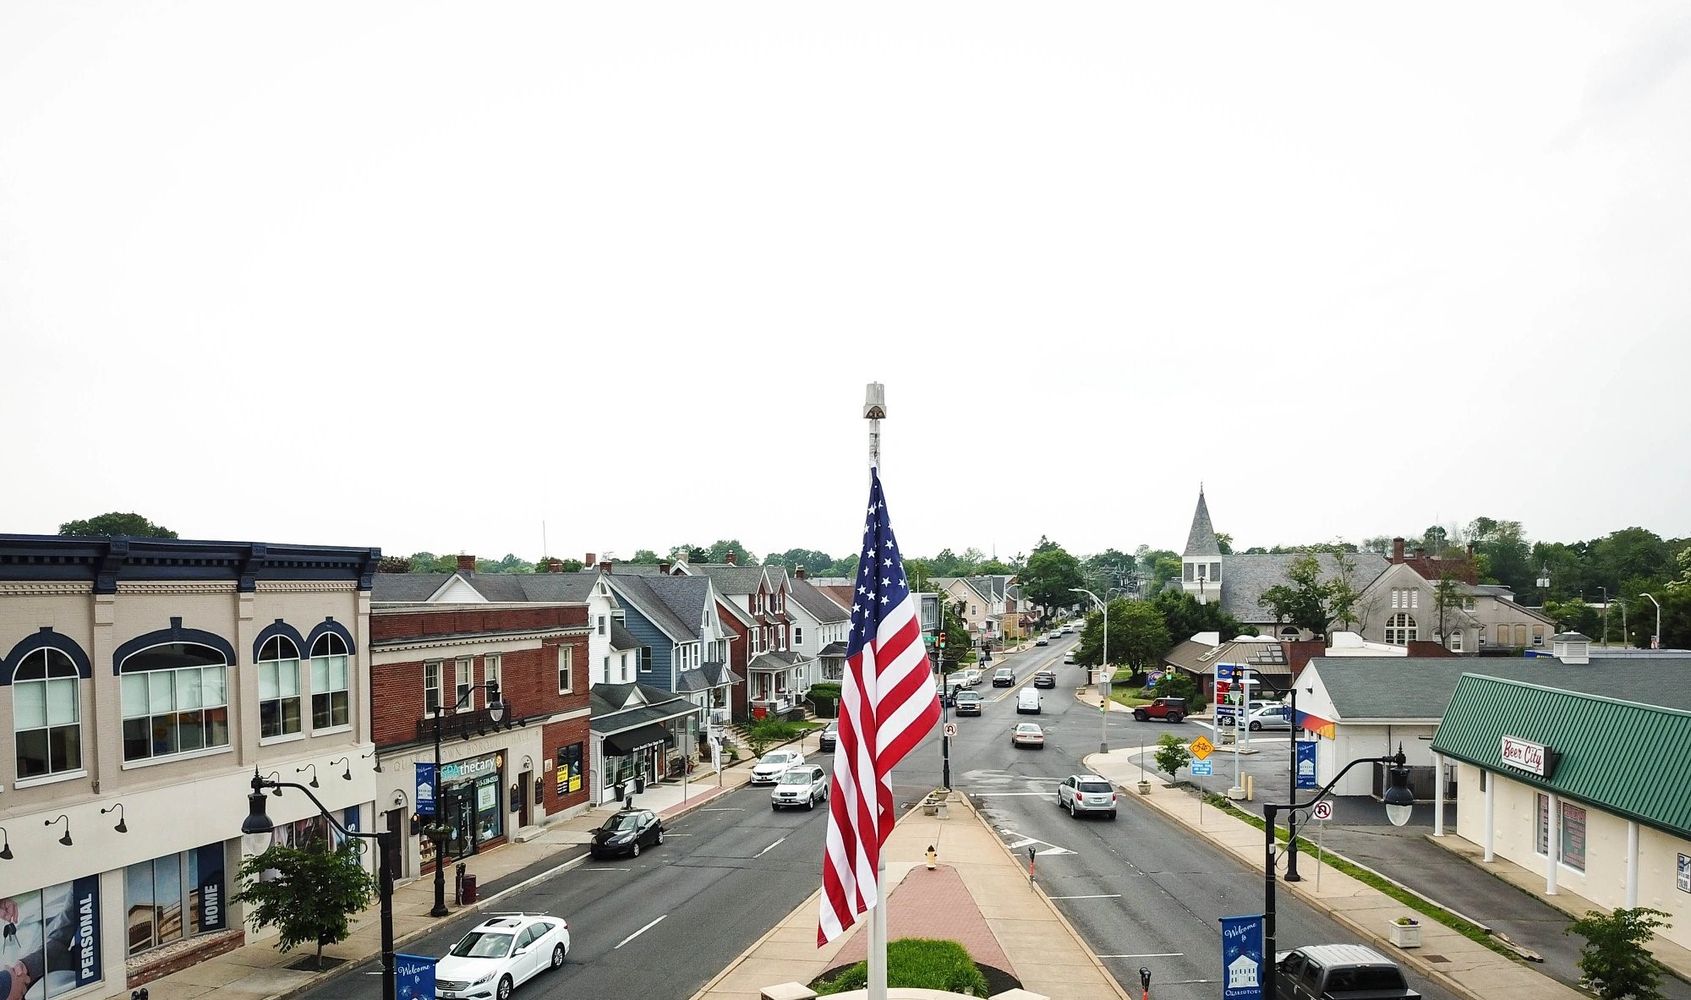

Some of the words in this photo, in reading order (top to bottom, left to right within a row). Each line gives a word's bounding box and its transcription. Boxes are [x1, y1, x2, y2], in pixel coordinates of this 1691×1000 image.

[1504, 740, 1521, 759] Beer
[1524, 746, 1542, 772] City
[204, 884, 219, 926] HOME
[79, 893, 94, 979] PERSONAL
[1224, 922, 1257, 939] Welcome
[397, 963, 431, 977] Welcome
